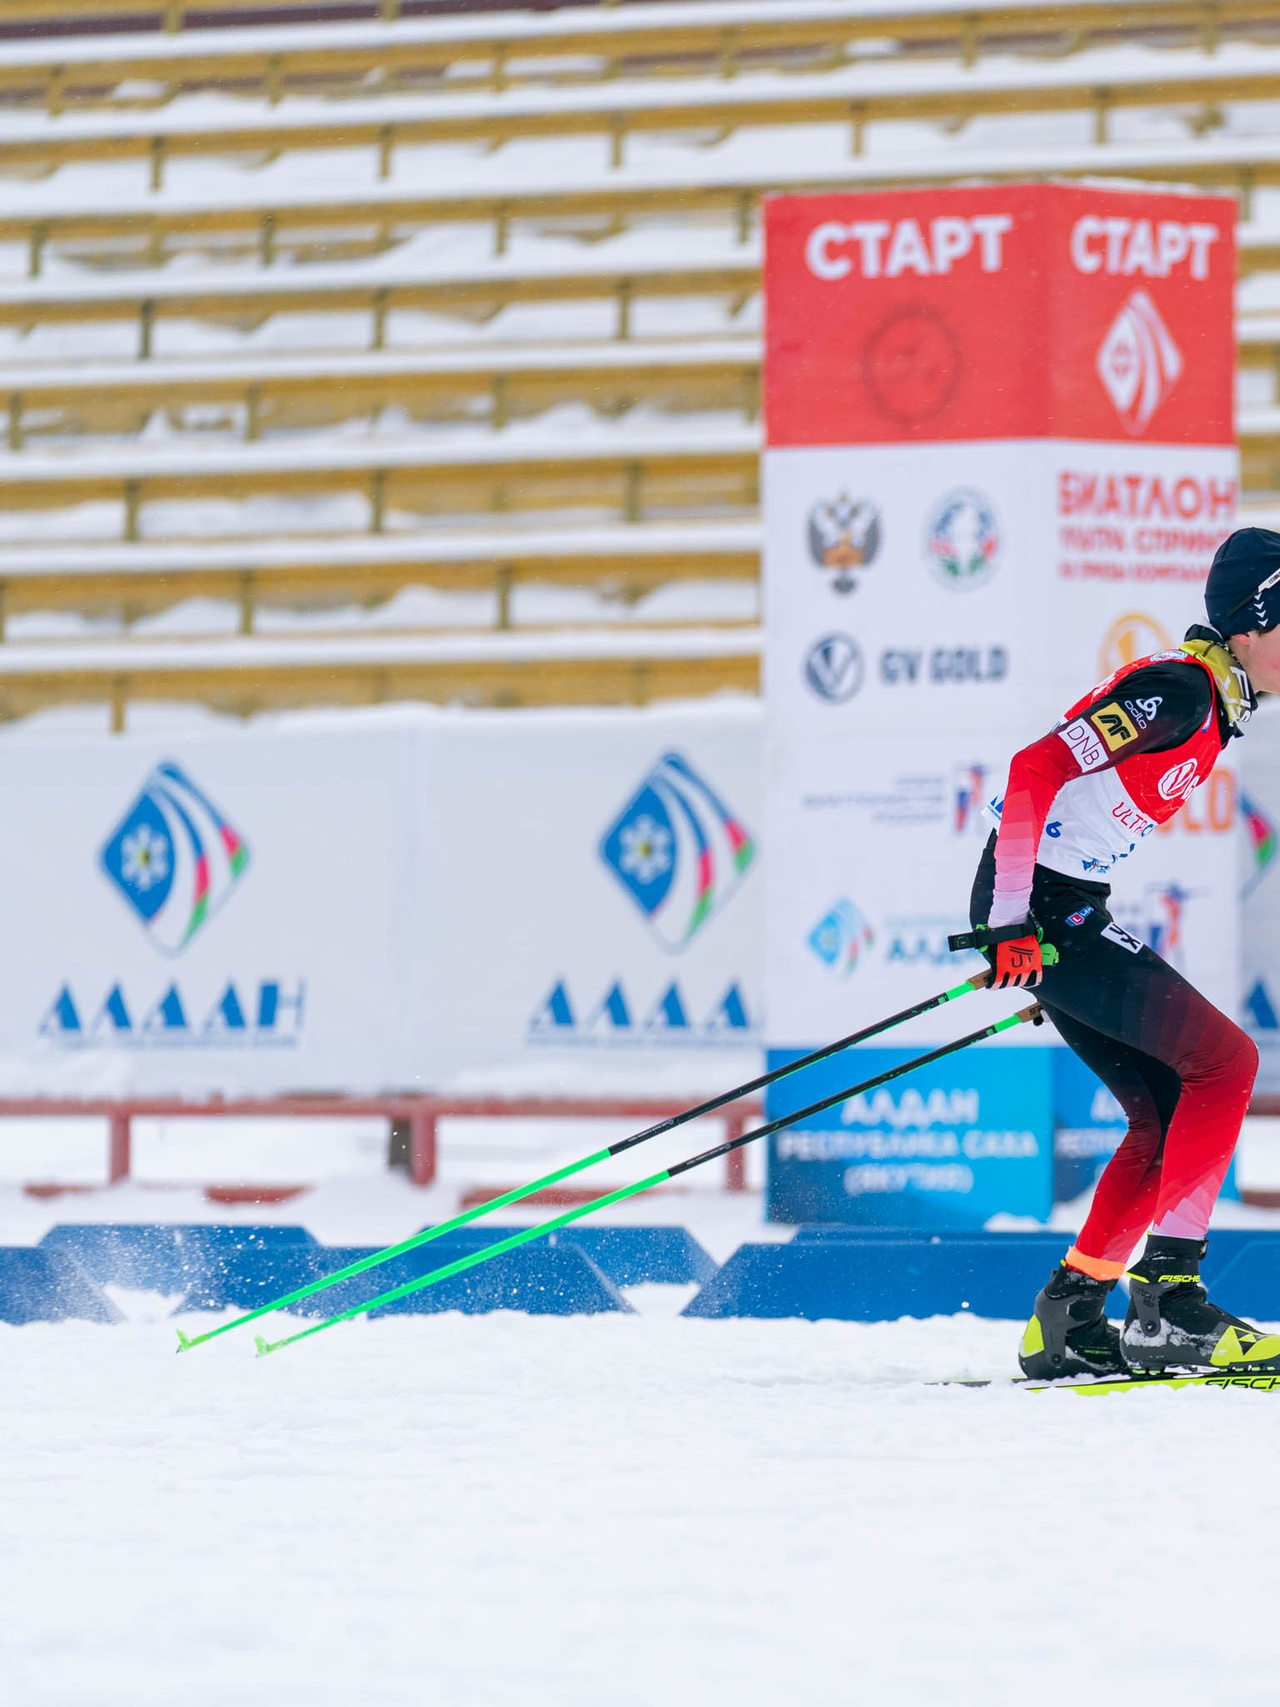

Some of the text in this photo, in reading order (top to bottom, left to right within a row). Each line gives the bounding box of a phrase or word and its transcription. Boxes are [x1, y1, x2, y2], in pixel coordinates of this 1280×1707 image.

[806, 215, 1011, 280] СТАРТ
[1071, 215, 1217, 280] СТАРТ
[1058, 470, 1237, 520] БИАТЛОН
[880, 645, 1009, 685] GV GOLD
[1124, 700, 1147, 729] odlo
[1066, 725, 1101, 766] DNB
